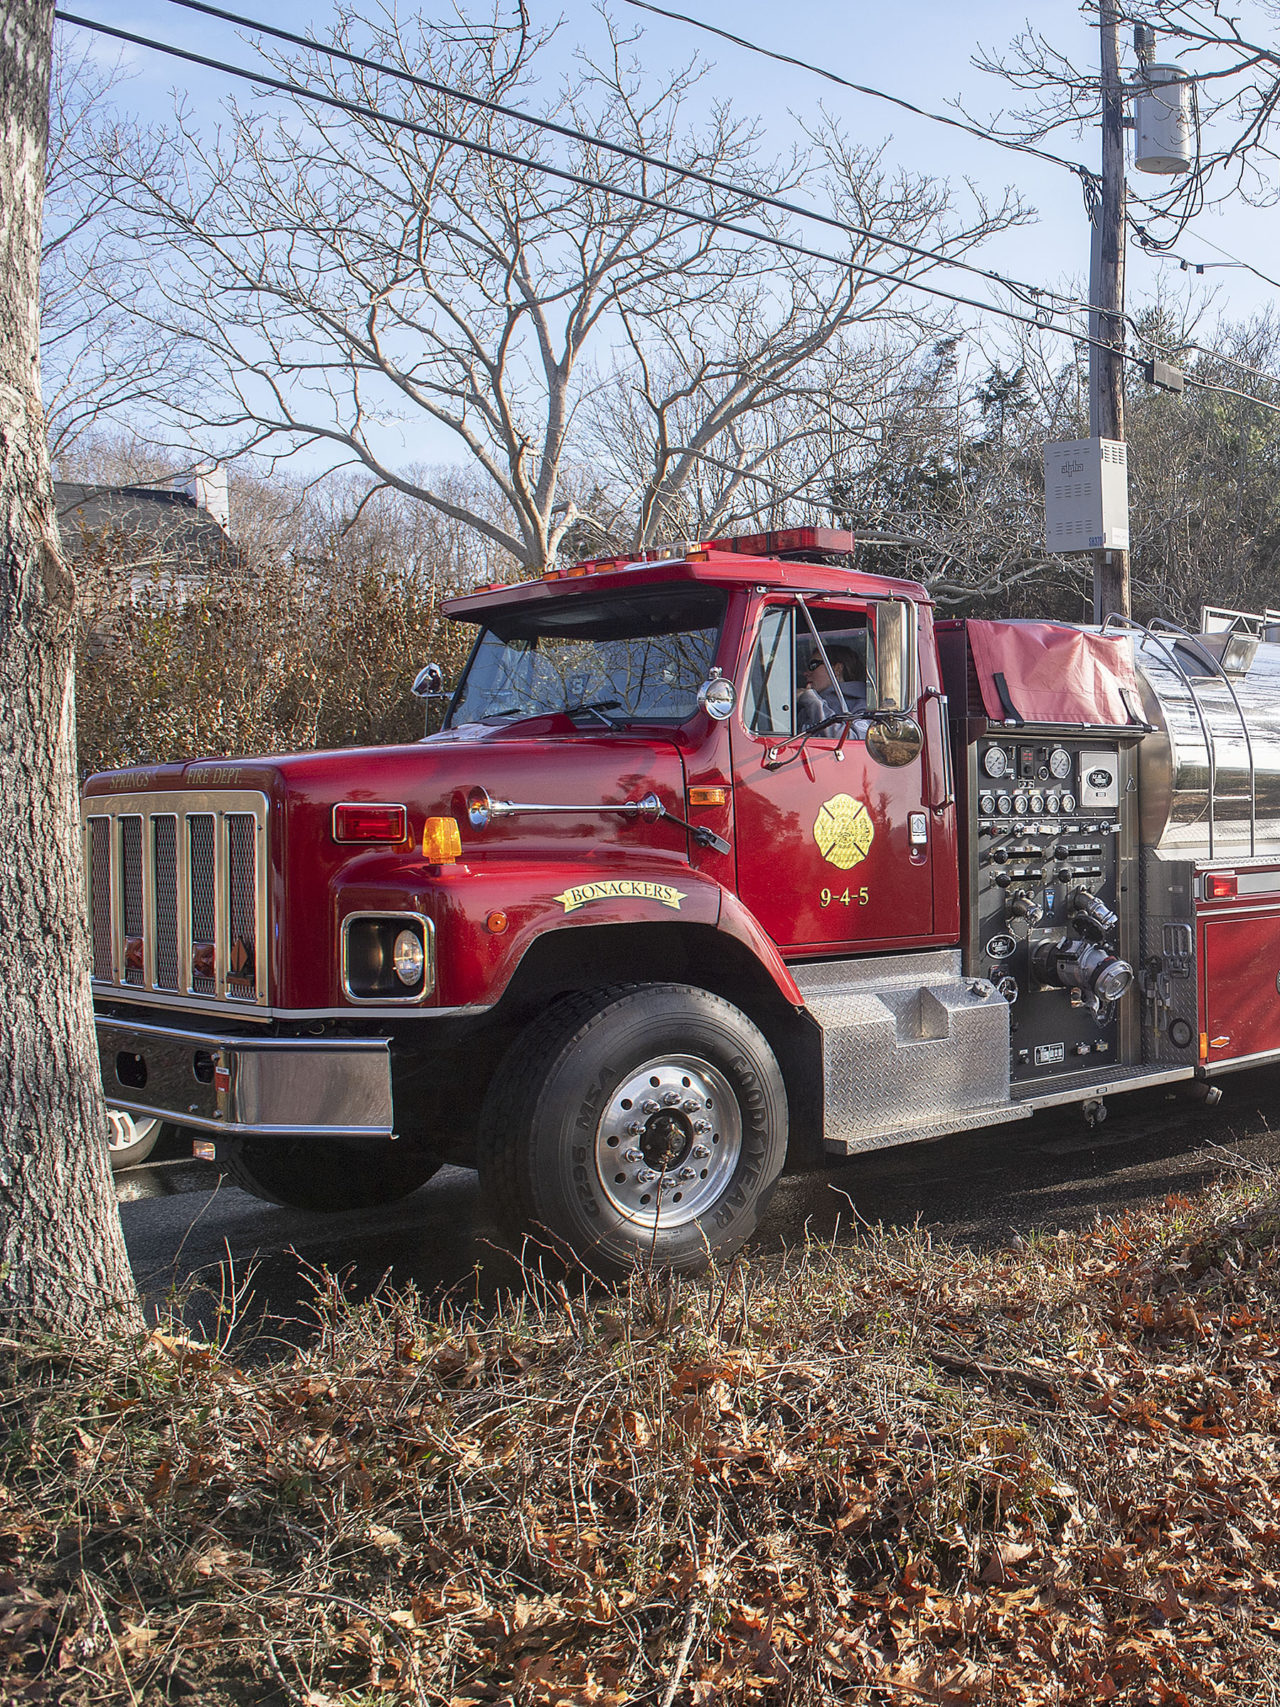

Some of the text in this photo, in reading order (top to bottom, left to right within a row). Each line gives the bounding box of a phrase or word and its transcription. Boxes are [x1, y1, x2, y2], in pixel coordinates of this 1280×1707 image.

[109, 767, 242, 789] SPRINGS FIRE DEPT.
[571, 881, 672, 902] BONACKERS
[820, 887, 869, 908] 9-4-5
[712, 1056, 767, 1229] GOODYEAR
